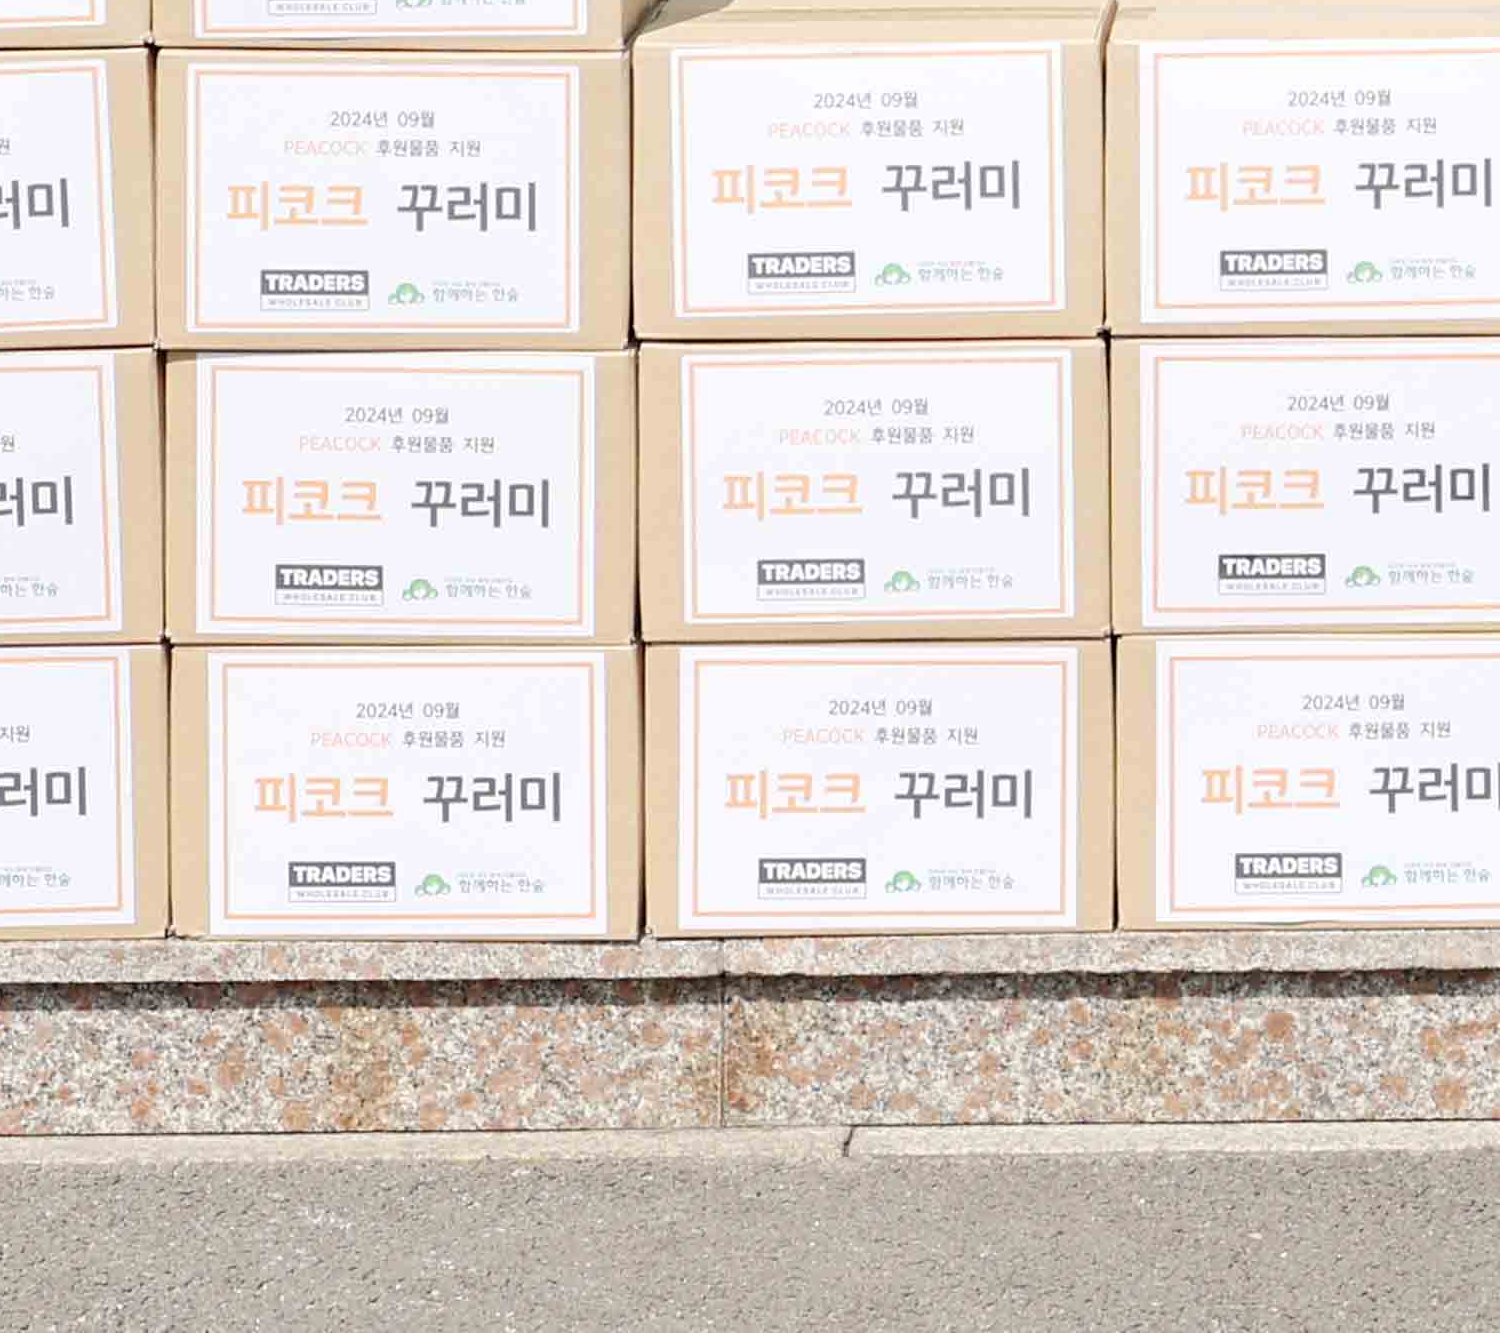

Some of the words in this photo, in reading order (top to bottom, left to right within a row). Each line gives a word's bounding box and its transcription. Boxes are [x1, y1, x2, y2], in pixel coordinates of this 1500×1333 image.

[813, 92, 872, 110] 2024년
[881, 91, 918, 109] 09월
[766, 119, 853, 141] PEACOCK
[862, 119, 925, 138] 후원물품
[932, 118, 964, 136] 지원
[711, 164, 853, 215] 피코크
[881, 159, 1021, 212] 꾸러미
[752, 254, 853, 279] TRADERS
